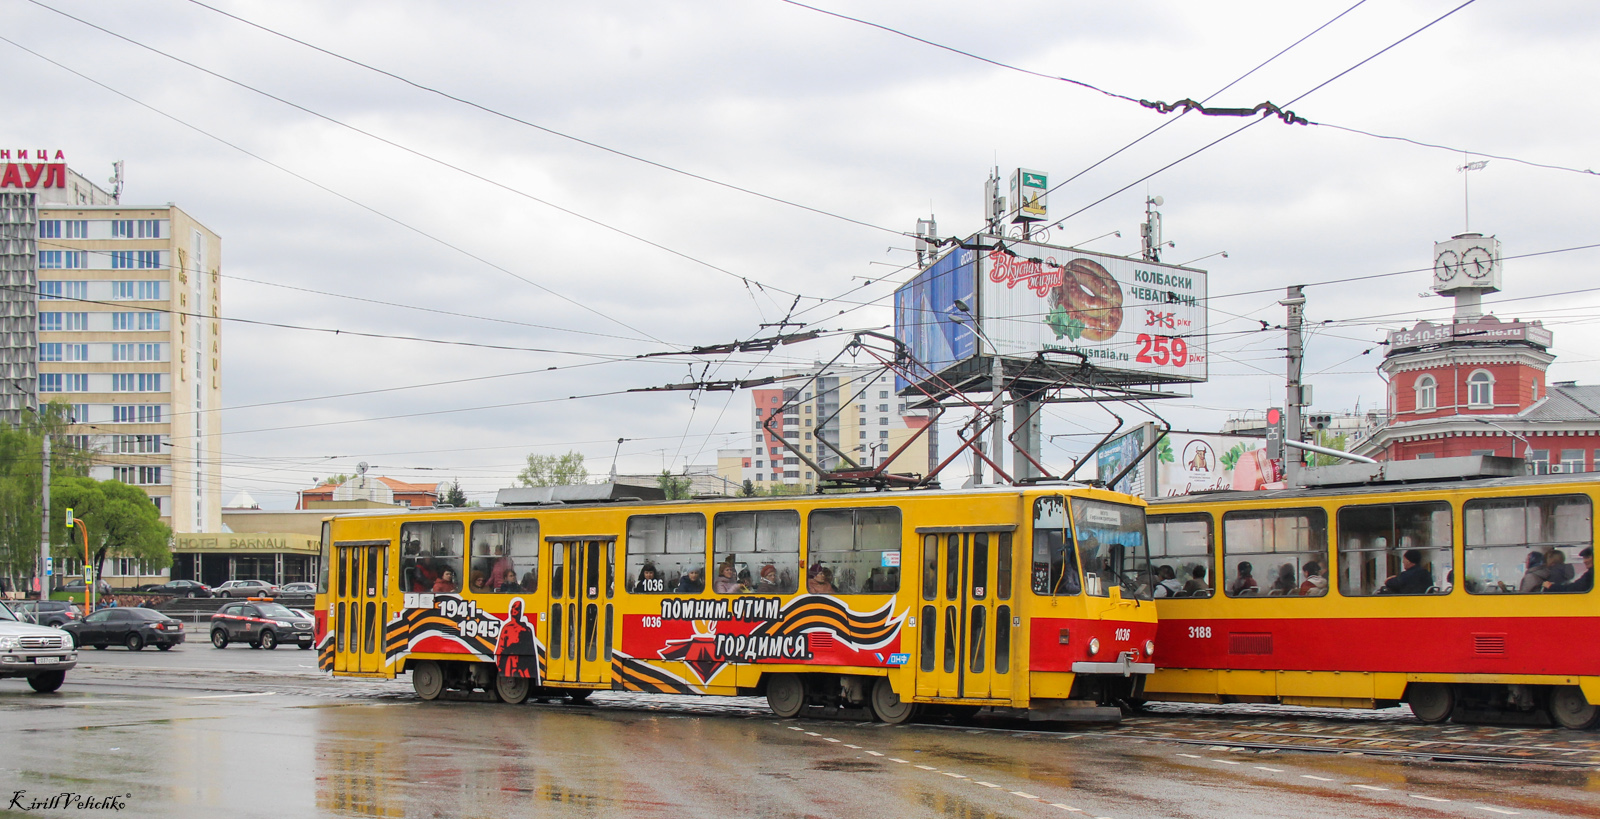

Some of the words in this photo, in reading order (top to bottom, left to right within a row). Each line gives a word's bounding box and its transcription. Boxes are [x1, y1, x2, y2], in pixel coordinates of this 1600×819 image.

[0, 163, 66, 189] АУЛ
[990, 250, 1042, 289] Вкусная
[1134, 269, 1192, 290] КОЛБАСКИ
[1145, 309, 1176, 330] 315
[1395, 327, 1450, 346] 36-10-55
[1135, 333, 1188, 368] 259
[179, 538, 219, 550] HOTEL
[229, 538, 291, 550] BARNAUL
[642, 579, 664, 592] 1036
[438, 601, 483, 618] 1941-
[458, 621, 500, 638] 1945
[641, 616, 662, 628] 1036
[1114, 627, 1131, 642] 1036
[1188, 626, 1212, 639] 3188
